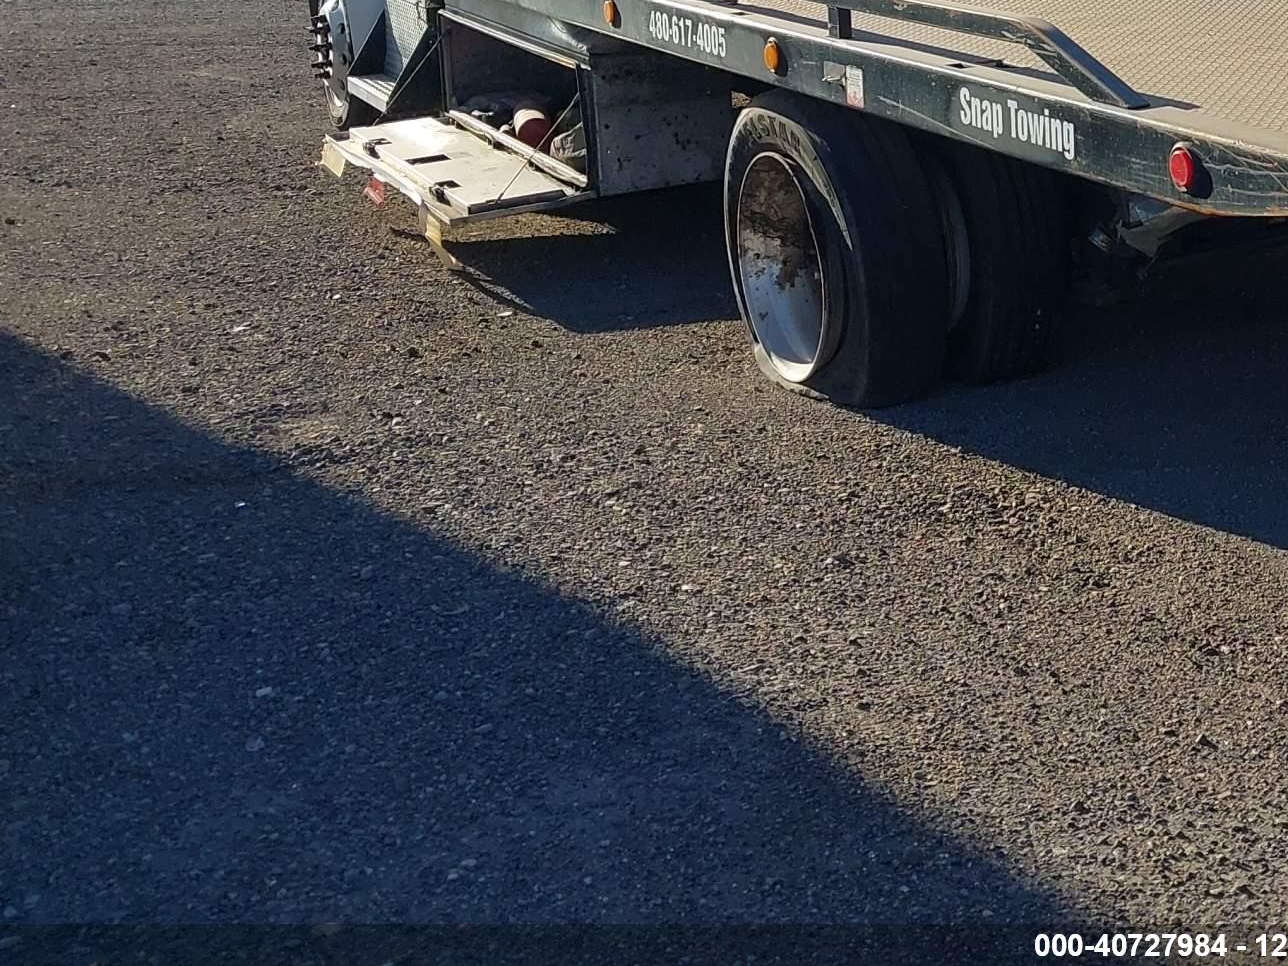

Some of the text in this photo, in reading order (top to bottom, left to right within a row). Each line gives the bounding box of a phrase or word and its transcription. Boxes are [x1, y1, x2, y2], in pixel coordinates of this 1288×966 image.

[649, 10, 727, 58] 480-617-4005
[959, 86, 1075, 161] Snap Towing
